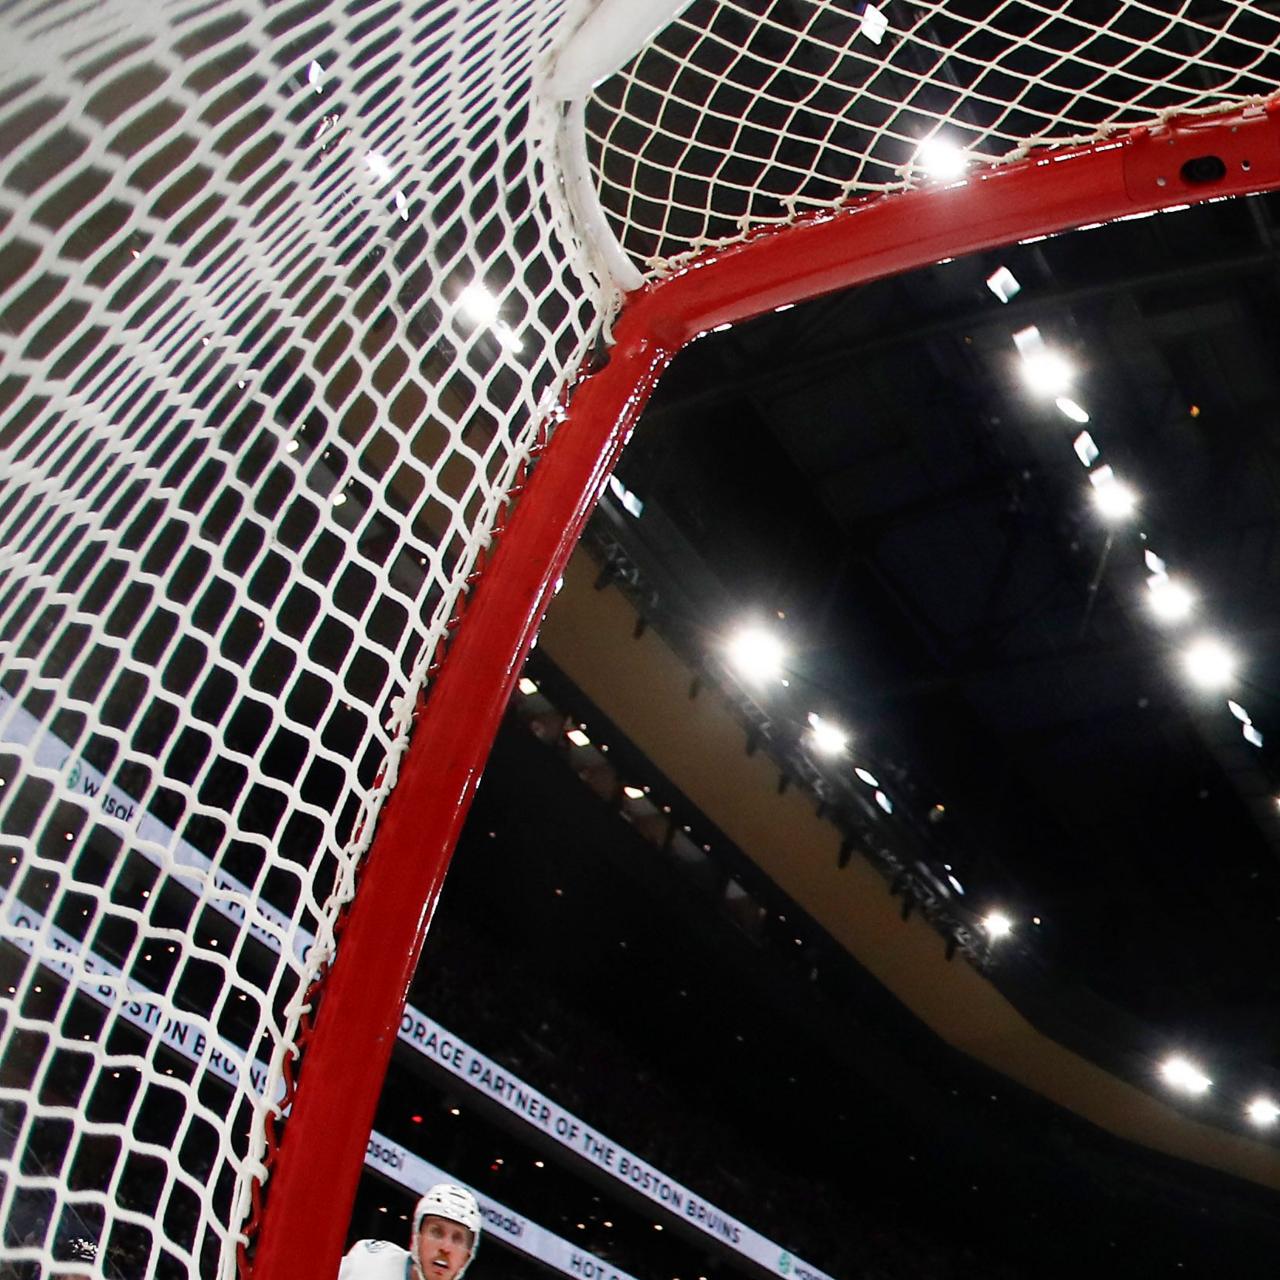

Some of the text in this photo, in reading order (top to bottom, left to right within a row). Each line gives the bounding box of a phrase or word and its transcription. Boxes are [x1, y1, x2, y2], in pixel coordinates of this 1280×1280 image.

[468, 1059, 552, 1127] PARTNER
[556, 1117, 580, 1145] OF
[583, 1132, 614, 1166] THE
[618, 1155, 683, 1208] BOSTON
[686, 1200, 742, 1245] BRUINS
